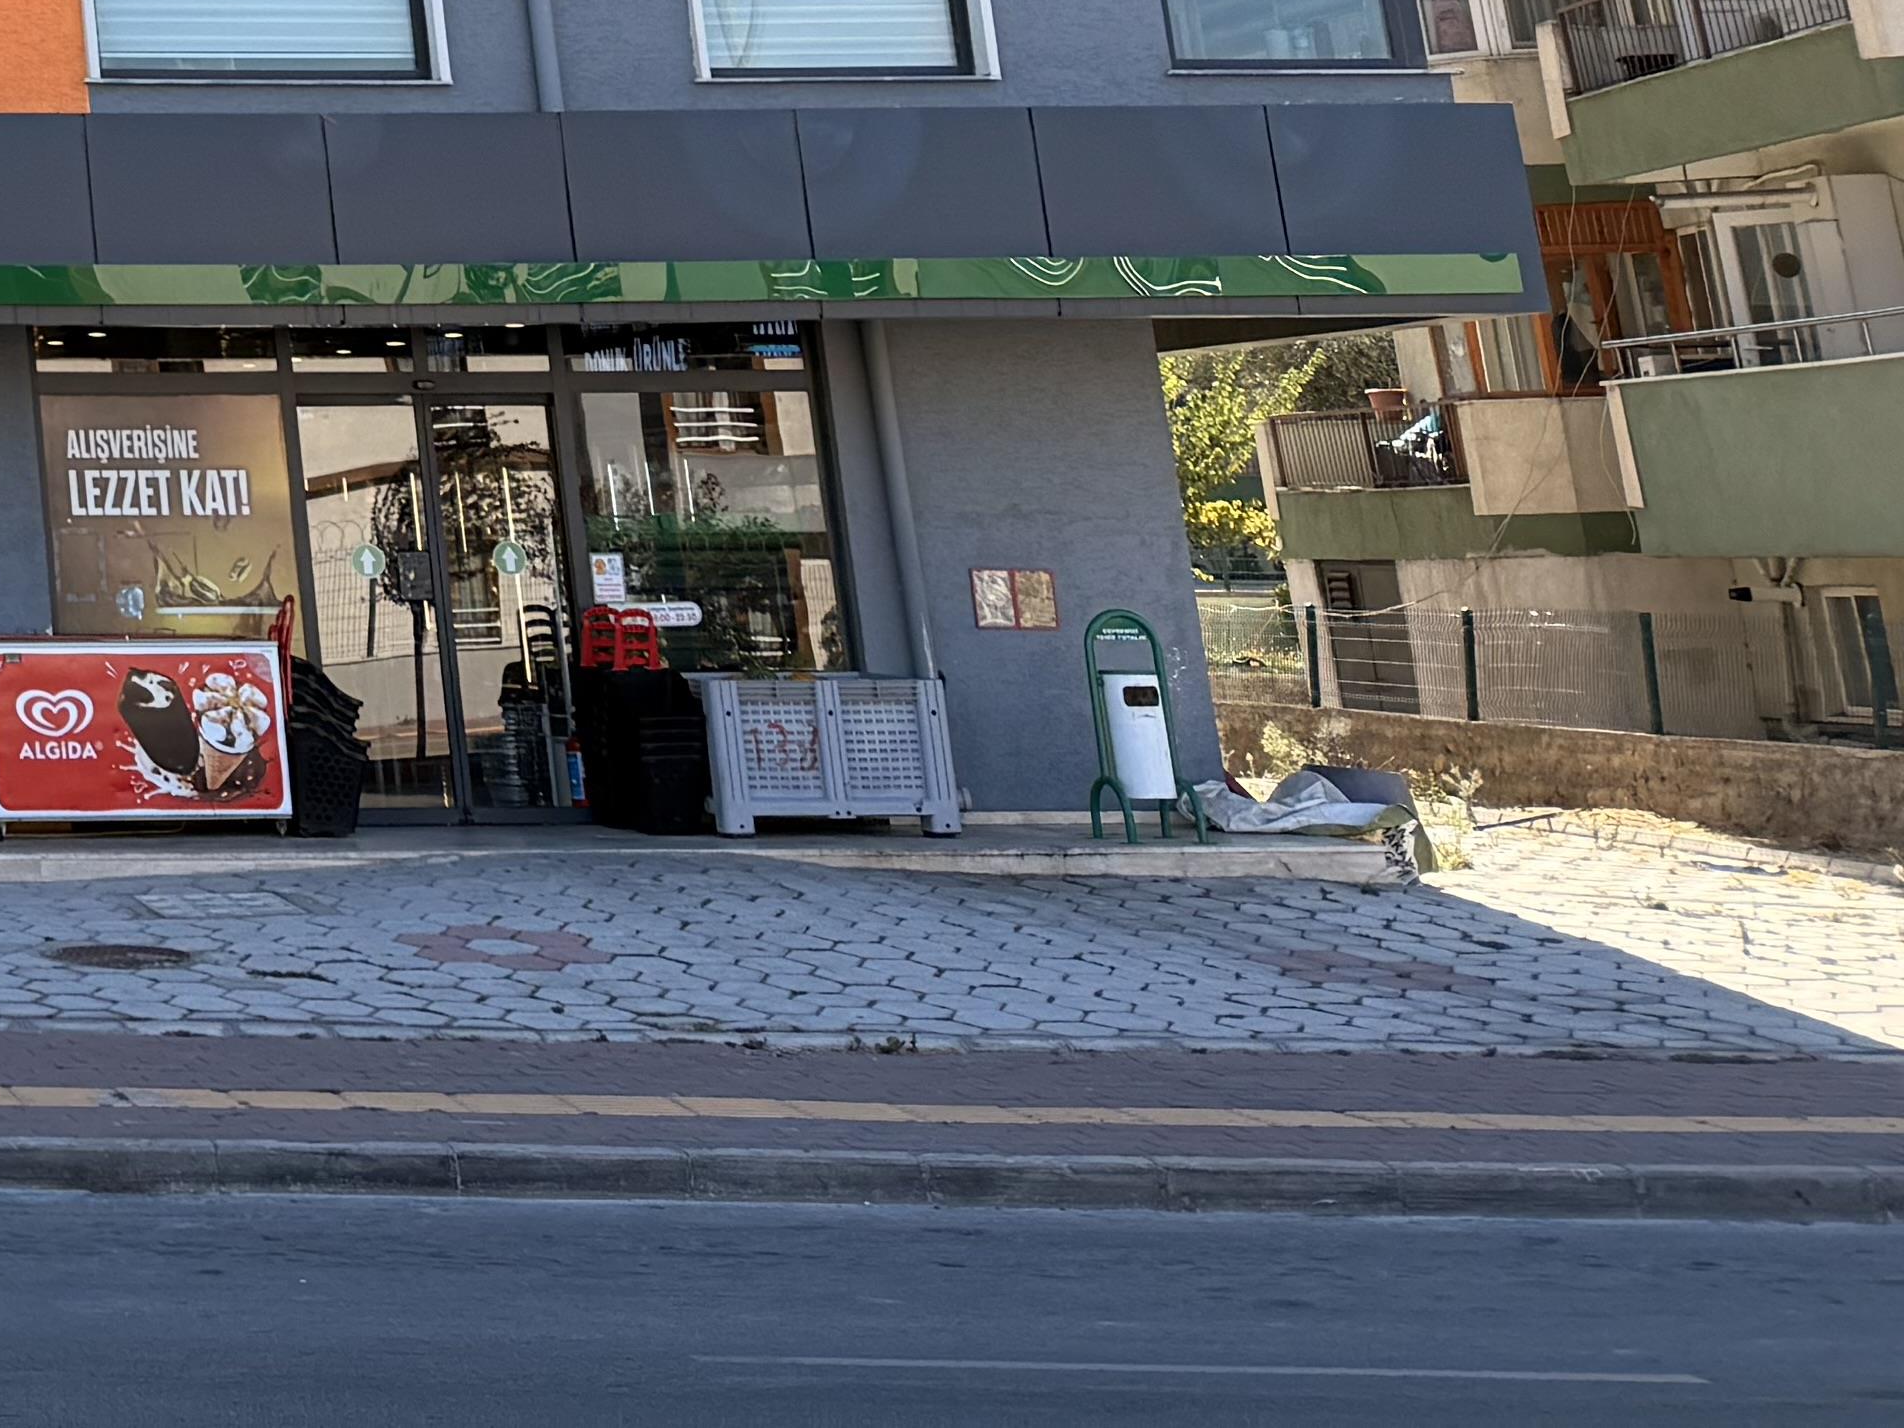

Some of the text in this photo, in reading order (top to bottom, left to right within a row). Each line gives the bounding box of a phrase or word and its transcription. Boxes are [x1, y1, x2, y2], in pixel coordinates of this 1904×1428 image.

[66, 424, 200, 465] ALIŞVERİŞİNE
[68, 468, 251, 517] LEZZET KAT!
[19, 740, 98, 761] ALGIDA
